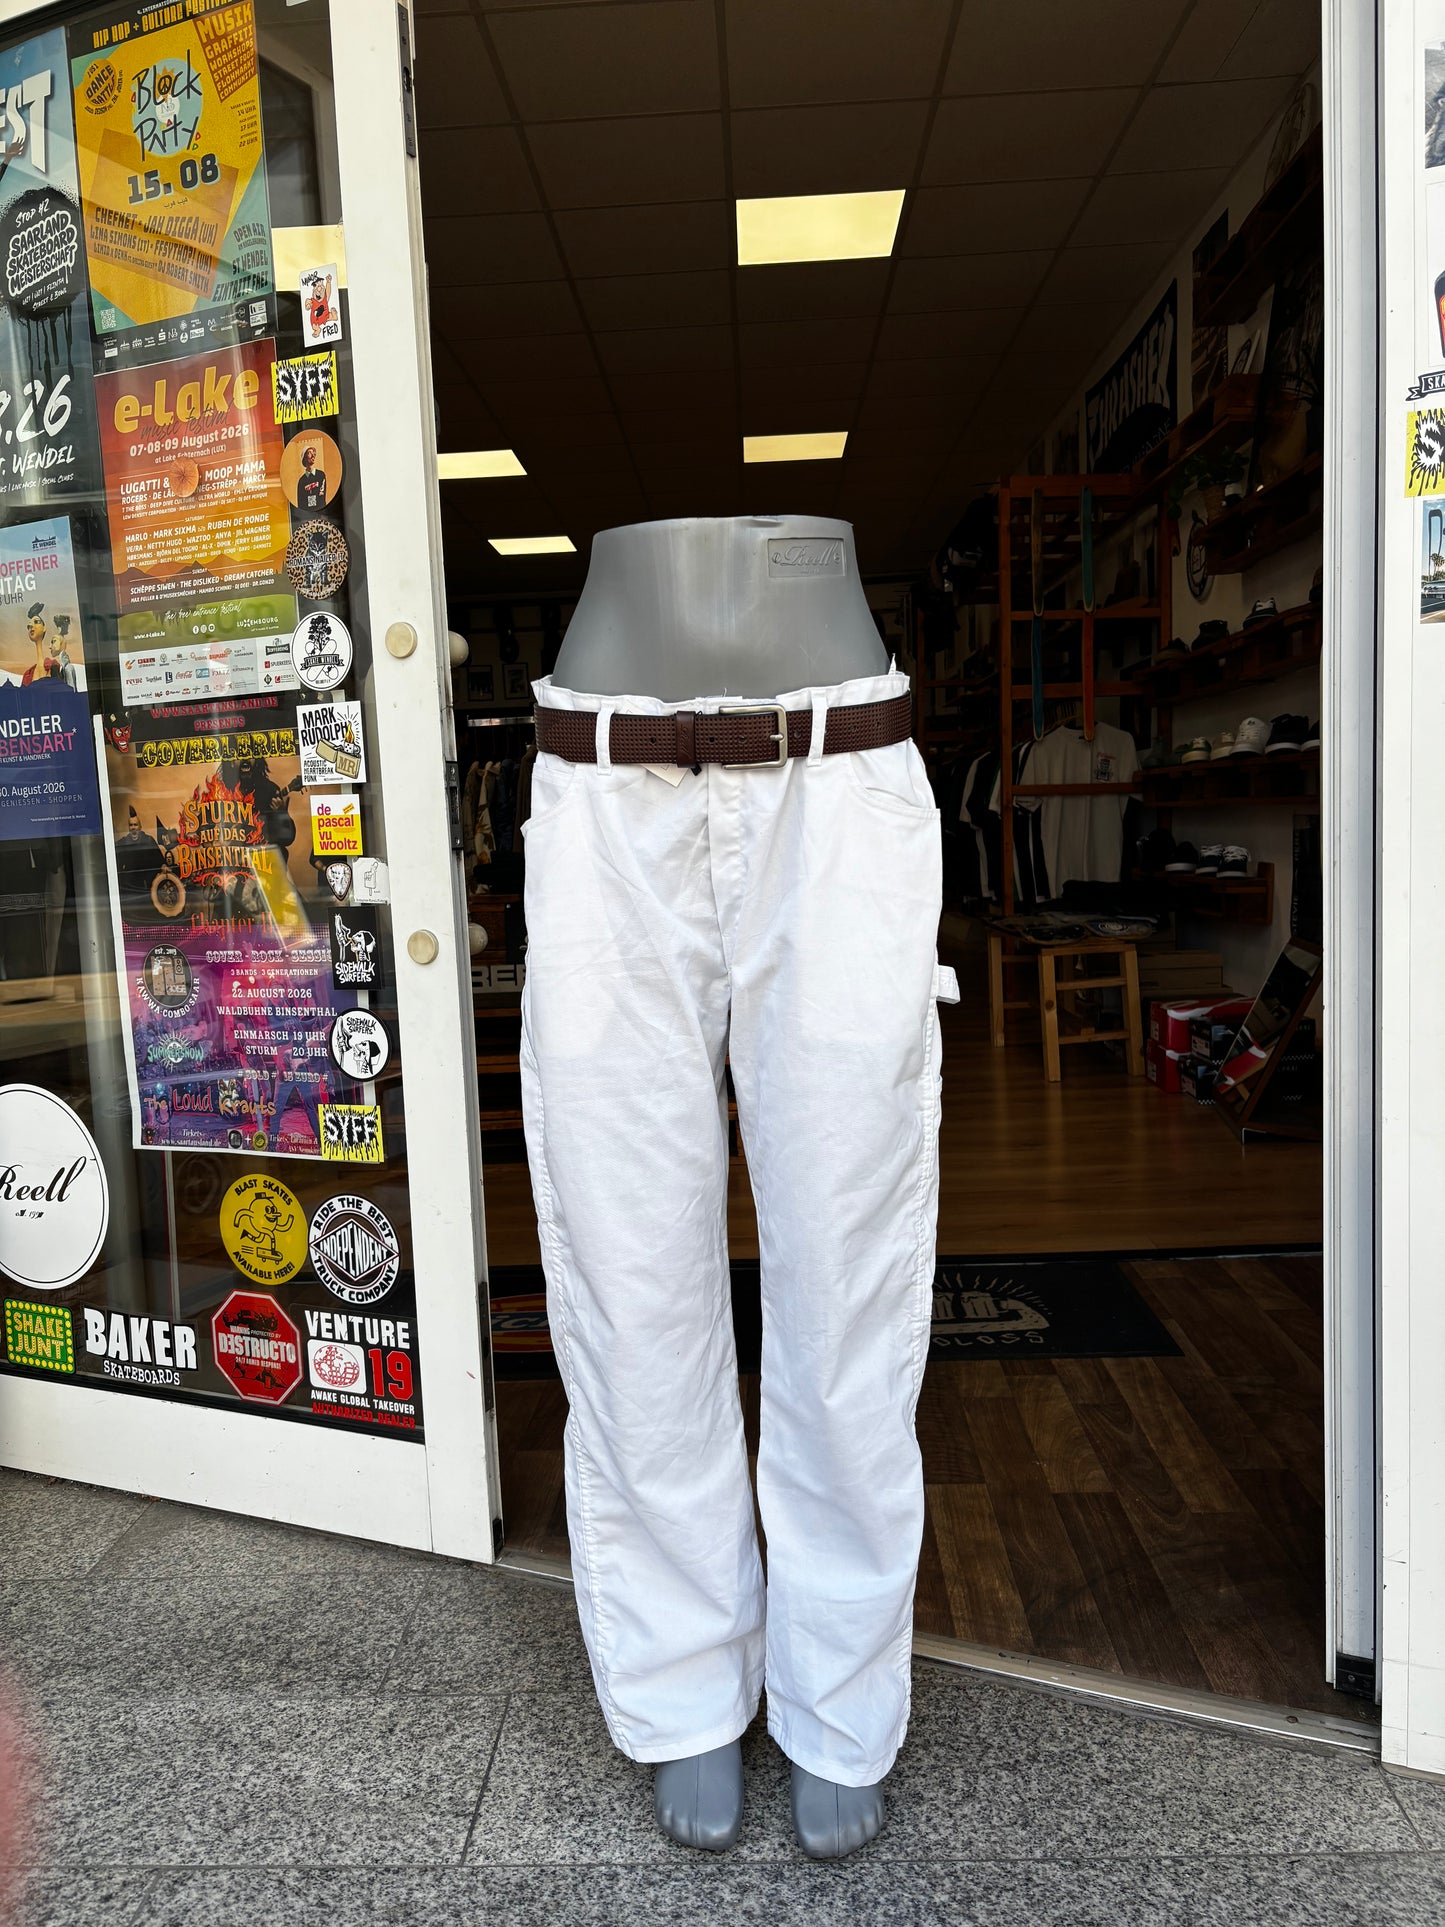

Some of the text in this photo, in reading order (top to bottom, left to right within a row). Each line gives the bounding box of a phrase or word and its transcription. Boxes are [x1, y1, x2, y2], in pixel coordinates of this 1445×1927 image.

[92, 28, 109, 48] HIP
[111, 21, 130, 43] HOP
[141, 3, 183, 32] CULTURE
[196, 3, 252, 43] MUSIK
[205, 25, 253, 59] GRAFFITI
[210, 38, 254, 71] WORKSHOPS
[213, 48, 254, 82] STREET FOOD
[217, 58, 254, 91] FLOHMARKT
[86, 65, 113, 99] DANCE
[91, 75, 115, 105] BATTLE
[219, 66, 255, 100] COMMUNITY
[0, 69, 51, 173] ST
[127, 153, 220, 205] 15. 08
[15, 198, 50, 228] STOP #2
[10, 211, 71, 258] SAARLAND
[144, 215, 165, 235] JAH
[165, 216, 200, 241] DIGGA
[233, 222, 266, 242] OPEN AIR
[7, 225, 77, 279] SKATEBOARD
[232, 250, 268, 275] ST WENDEL
[9, 244, 77, 296] MEISTERSCHAFT
[212, 271, 269, 303] EINTRITT FREI
[322, 323, 339, 339] FRED
[277, 361, 331, 403] SYFF
[114, 366, 259, 433] e-Lake
[140, 398, 234, 442] music festival
[181, 430, 219, 450] August
[221, 423, 249, 440] 2026
[12, 444, 76, 477] WENDEL
[205, 459, 265, 481] MOOP MAMA
[120, 477, 170, 495] LUGATTI &
[125, 513, 270, 543] MARLO MARK SIXMA RUBEN DE RONDE
[39, 540, 57, 549] WENDEL
[0, 554, 59, 578] OFFENER
[157, 568, 274, 591] SIWEN THE DISLIKED DREAM CATCHER
[4, 592, 24, 604] UHR
[194, 717, 245, 731] PRESENTS
[302, 706, 336, 729] MARK
[301, 721, 348, 747] RUDOLPH
[142, 729, 296, 768] COVERLERIE
[304, 760, 327, 768] ACOUSTIC
[304, 767, 334, 775] HEARTBREAK
[337, 756, 356, 774] MR
[1, 794, 83, 808] GENIESSEN SHOPPEN
[11, 782, 65, 798] August 2026
[184, 800, 254, 834] STURM
[317, 803, 331, 816] de
[317, 814, 354, 830] pascal
[200, 828, 246, 843] AUF DAS
[319, 831, 332, 840] vu
[319, 838, 358, 850] wooltz
[177, 844, 273, 880] BINSENTHAL
[205, 949, 284, 963] COVER ROCK
[335, 961, 376, 976] SIDEWALK
[266, 968, 319, 977] GENERATIONEN
[339, 972, 372, 984] SURFERS
[232, 988, 312, 998] 22. AUGUST 2026
[275, 1006, 338, 1017] BINSENTHAL
[346, 1016, 377, 1031] SIDEWALK
[233, 1030, 327, 1041] EINMARSCH 19 UHR
[349, 1025, 374, 1035] SURFERS
[148, 1044, 203, 1064] SUMMERSNOW
[246, 1045, 328, 1057] STURM 20 UHR
[144, 1086, 276, 1116] The Loud Krauts
[324, 1110, 376, 1147] SYFF
[0, 1156, 87, 1202] Reell
[234, 1179, 293, 1206] BLAST SKATES
[313, 1197, 394, 1239] RIDE THE BEST
[319, 1222, 388, 1277] INDEPENDENT
[233, 1251, 296, 1279] AVAILABLE HERE!
[313, 1259, 396, 1302] TRUCK COMPANY
[13, 1311, 64, 1339] SHAKE
[84, 1307, 198, 1369] BAKER
[229, 1325, 250, 1335] WARNING
[251, 1330, 275, 1338] PROTECTED
[304, 1310, 410, 1349] VENTURE
[15, 1334, 64, 1360] JUNT
[218, 1332, 296, 1364] DESTRUCTO
[103, 1359, 181, 1386] SKATEBOARDS
[246, 1358, 260, 1366] ARMED
[260, 1360, 282, 1370] RESPONSE
[368, 1348, 413, 1401] 19
[310, 1389, 415, 1415] AWAKE GLOBAL TAKEOVER
[311, 1402, 416, 1429] AUTHORIZED DEALER
